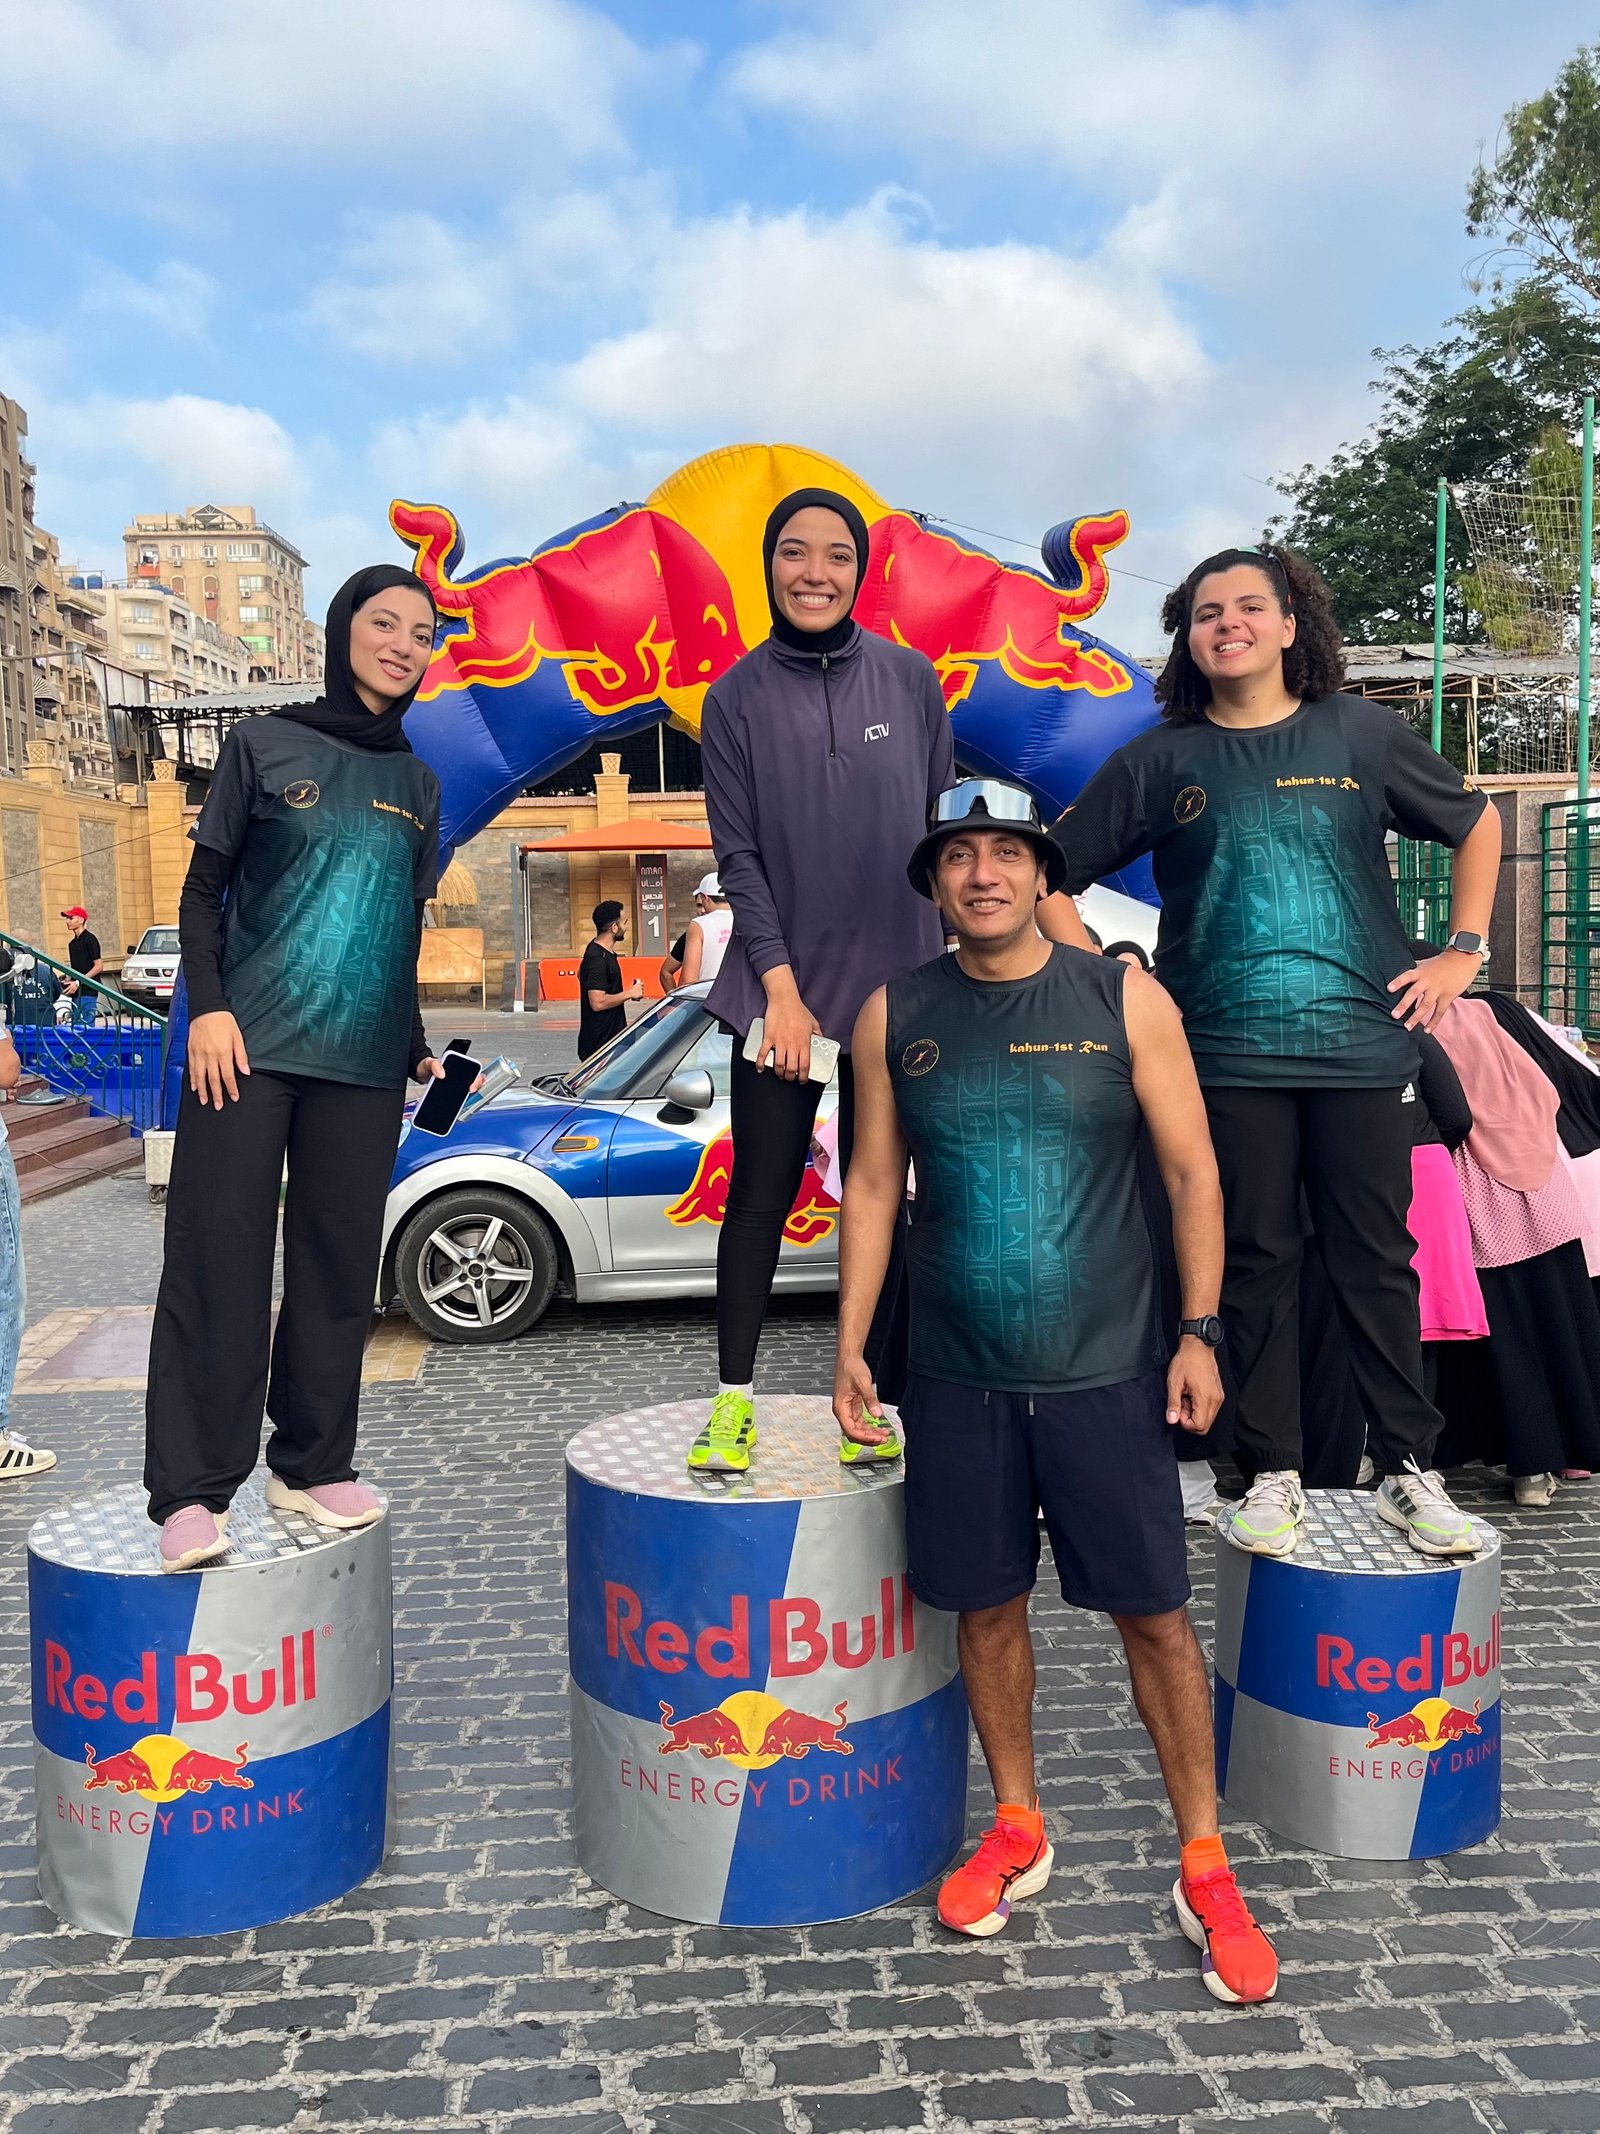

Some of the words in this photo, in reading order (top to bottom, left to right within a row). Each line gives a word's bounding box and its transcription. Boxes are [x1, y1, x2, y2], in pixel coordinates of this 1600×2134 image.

[647, 915, 660, 937] 1
[1009, 1042, 1074, 1053] kahun-1st
[1078, 1040, 1109, 1053] Run
[604, 1580, 750, 1679] Red
[769, 1572, 915, 1679] Bull
[1315, 1633, 1432, 1693] Red
[1442, 1609, 1500, 1688] Bull
[45, 1639, 159, 1724] Red
[174, 1628, 316, 1724] Bull
[621, 1759, 768, 1807] ENERGY
[788, 1756, 902, 1807] DRINK
[1329, 1757, 1441, 1780] ENERGY
[1451, 1736, 1499, 1773] DRINK
[56, 1795, 174, 1836] ENERGY
[192, 1788, 305, 1835] DRINK
